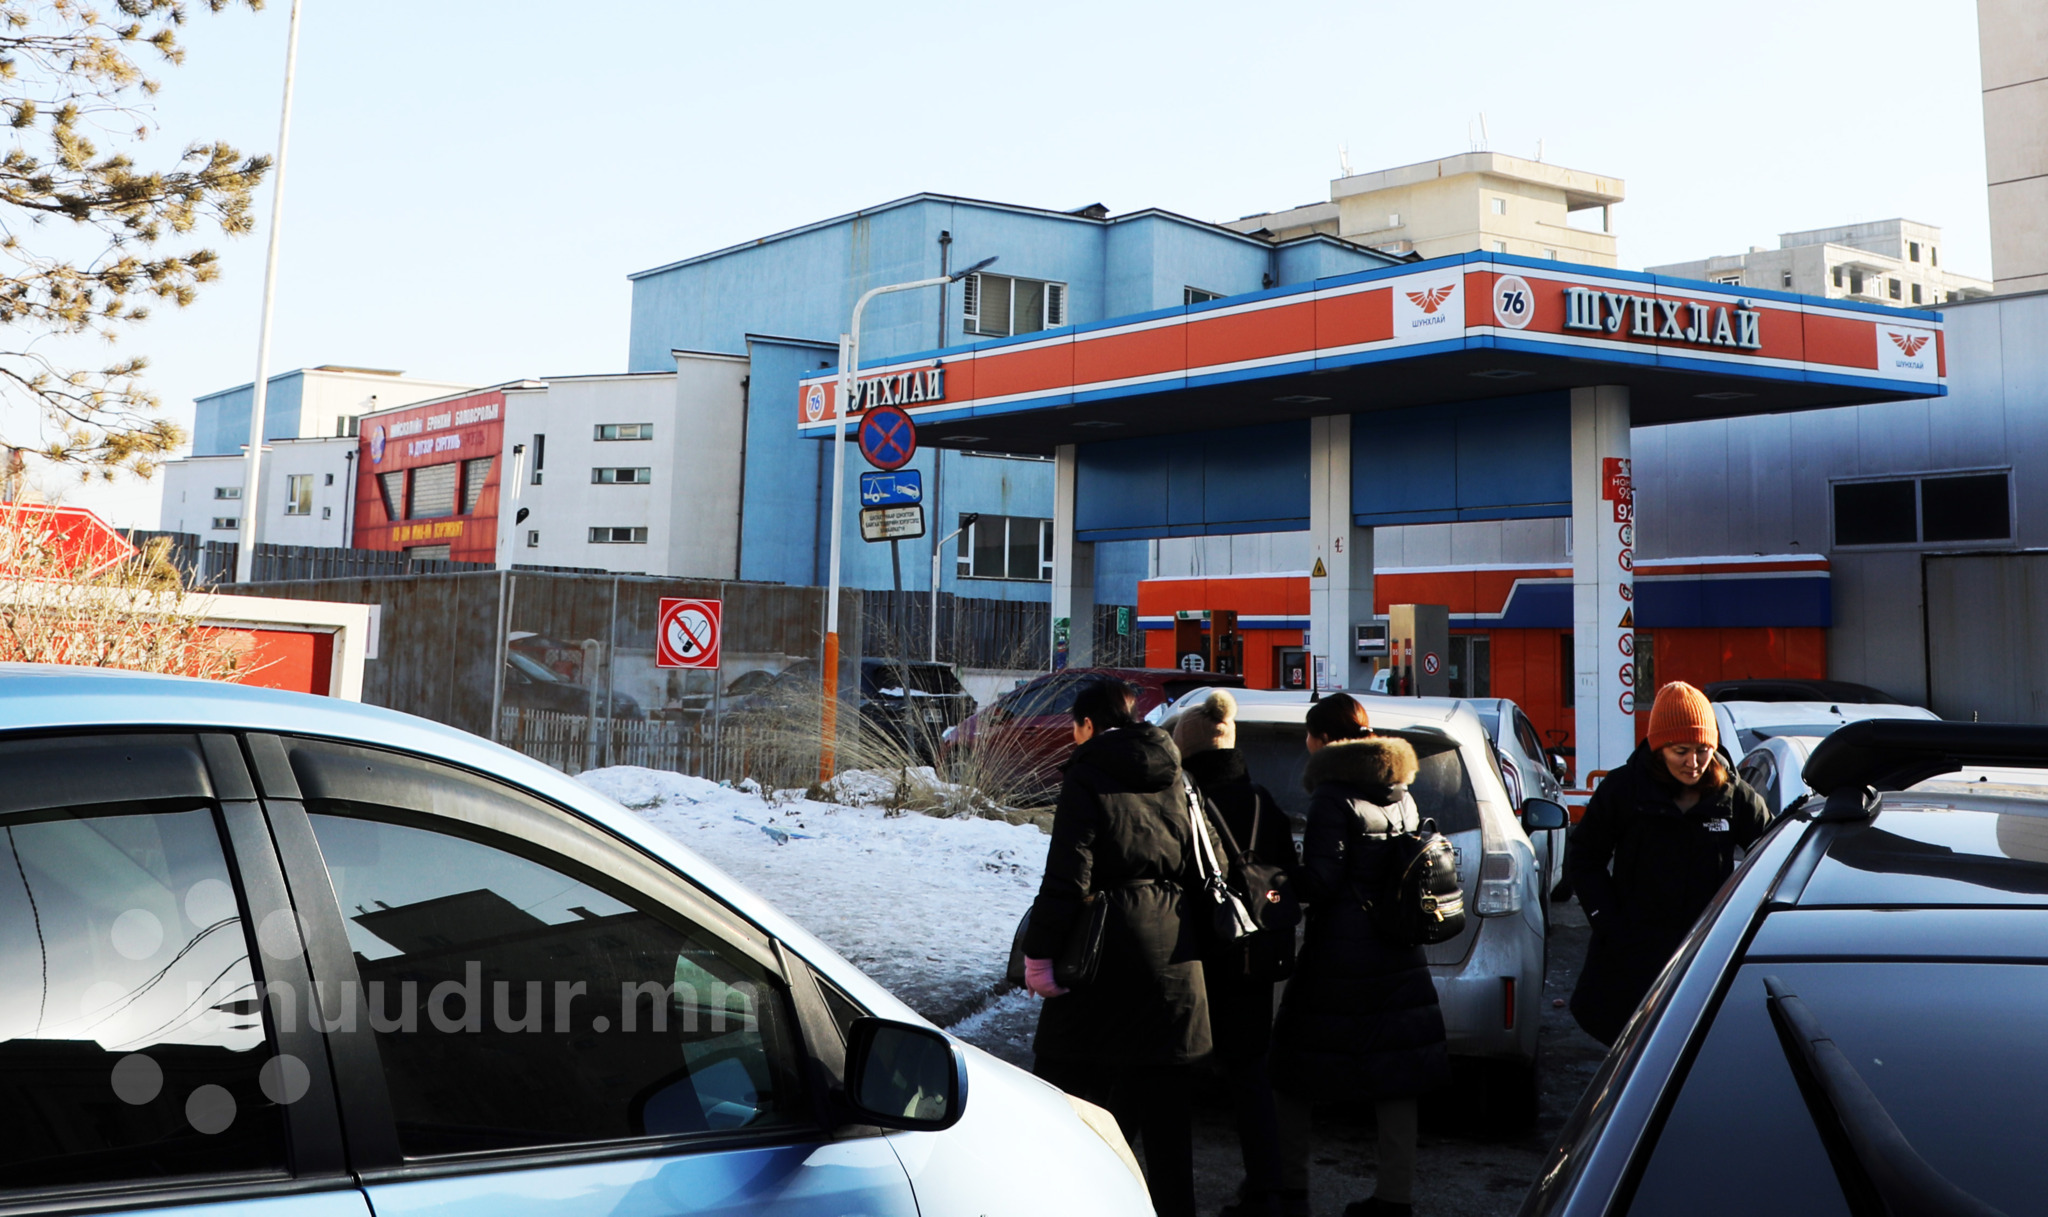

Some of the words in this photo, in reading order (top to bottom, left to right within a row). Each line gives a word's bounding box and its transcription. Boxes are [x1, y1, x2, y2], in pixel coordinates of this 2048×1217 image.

[1502, 291, 1526, 314] 76
[1412, 314, 1446, 328] ШУНХЛАЙ
[1564, 286, 1761, 349] ШУНХЛАЙ
[810, 394, 821, 411] 76
